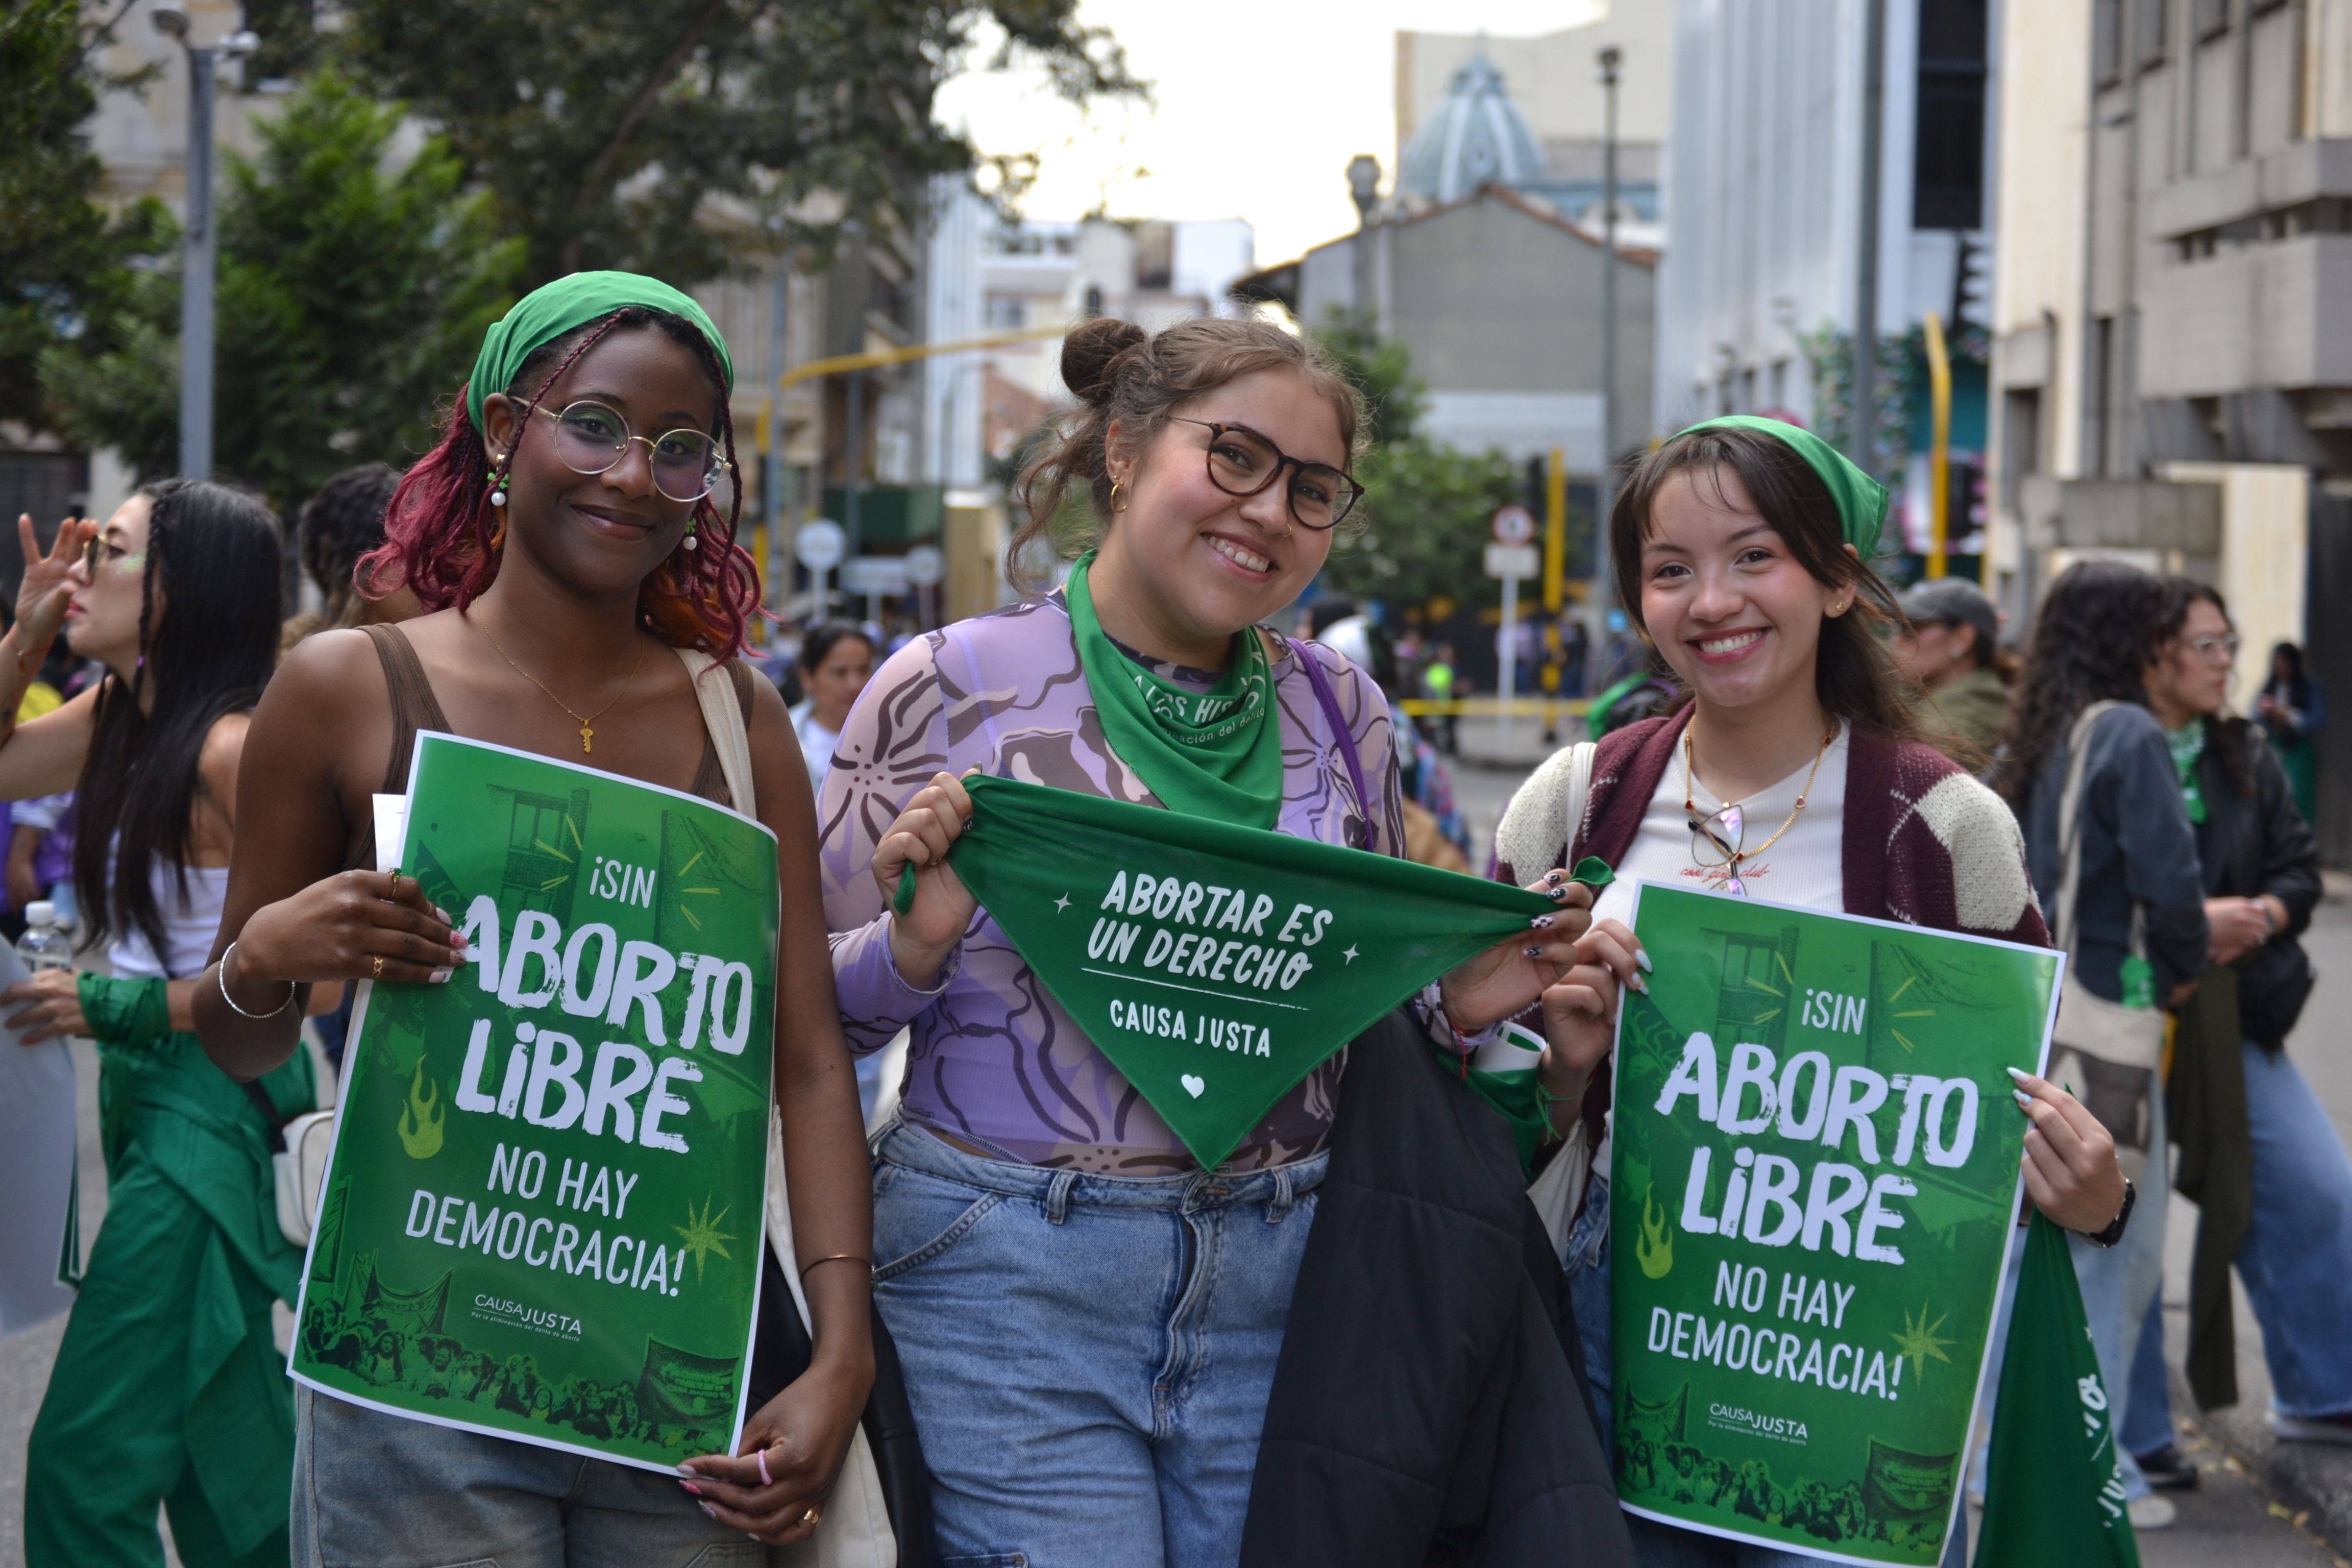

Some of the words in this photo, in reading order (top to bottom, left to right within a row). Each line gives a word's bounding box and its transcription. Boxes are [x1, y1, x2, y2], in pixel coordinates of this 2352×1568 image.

[1219, 721, 1235, 737] del
[1101, 871, 1273, 936] ABORTAR
[1279, 904, 1332, 945] ES
[460, 896, 752, 1055] ABORTO
[1088, 918, 1140, 963] UN
[1144, 929, 1311, 990] DERECHO
[1111, 1000, 1186, 1039] CAUSA
[1195, 1016, 1269, 1057] JUSTA
[1655, 1032, 1978, 1167] ABORTO
[488, 1143, 546, 1198] NO
[557, 1159, 638, 1219] HAY
[406, 1190, 684, 1296] DEMOCRACIA!
[490, 1317, 523, 1328] eliminación
[535, 1327, 551, 1335] delito
[561, 1333, 580, 1342] aborto
[1714, 1262, 1766, 1312] NO
[1778, 1273, 1854, 1328] HAY
[1649, 1308, 1902, 1400] DEMOCRACIA!
